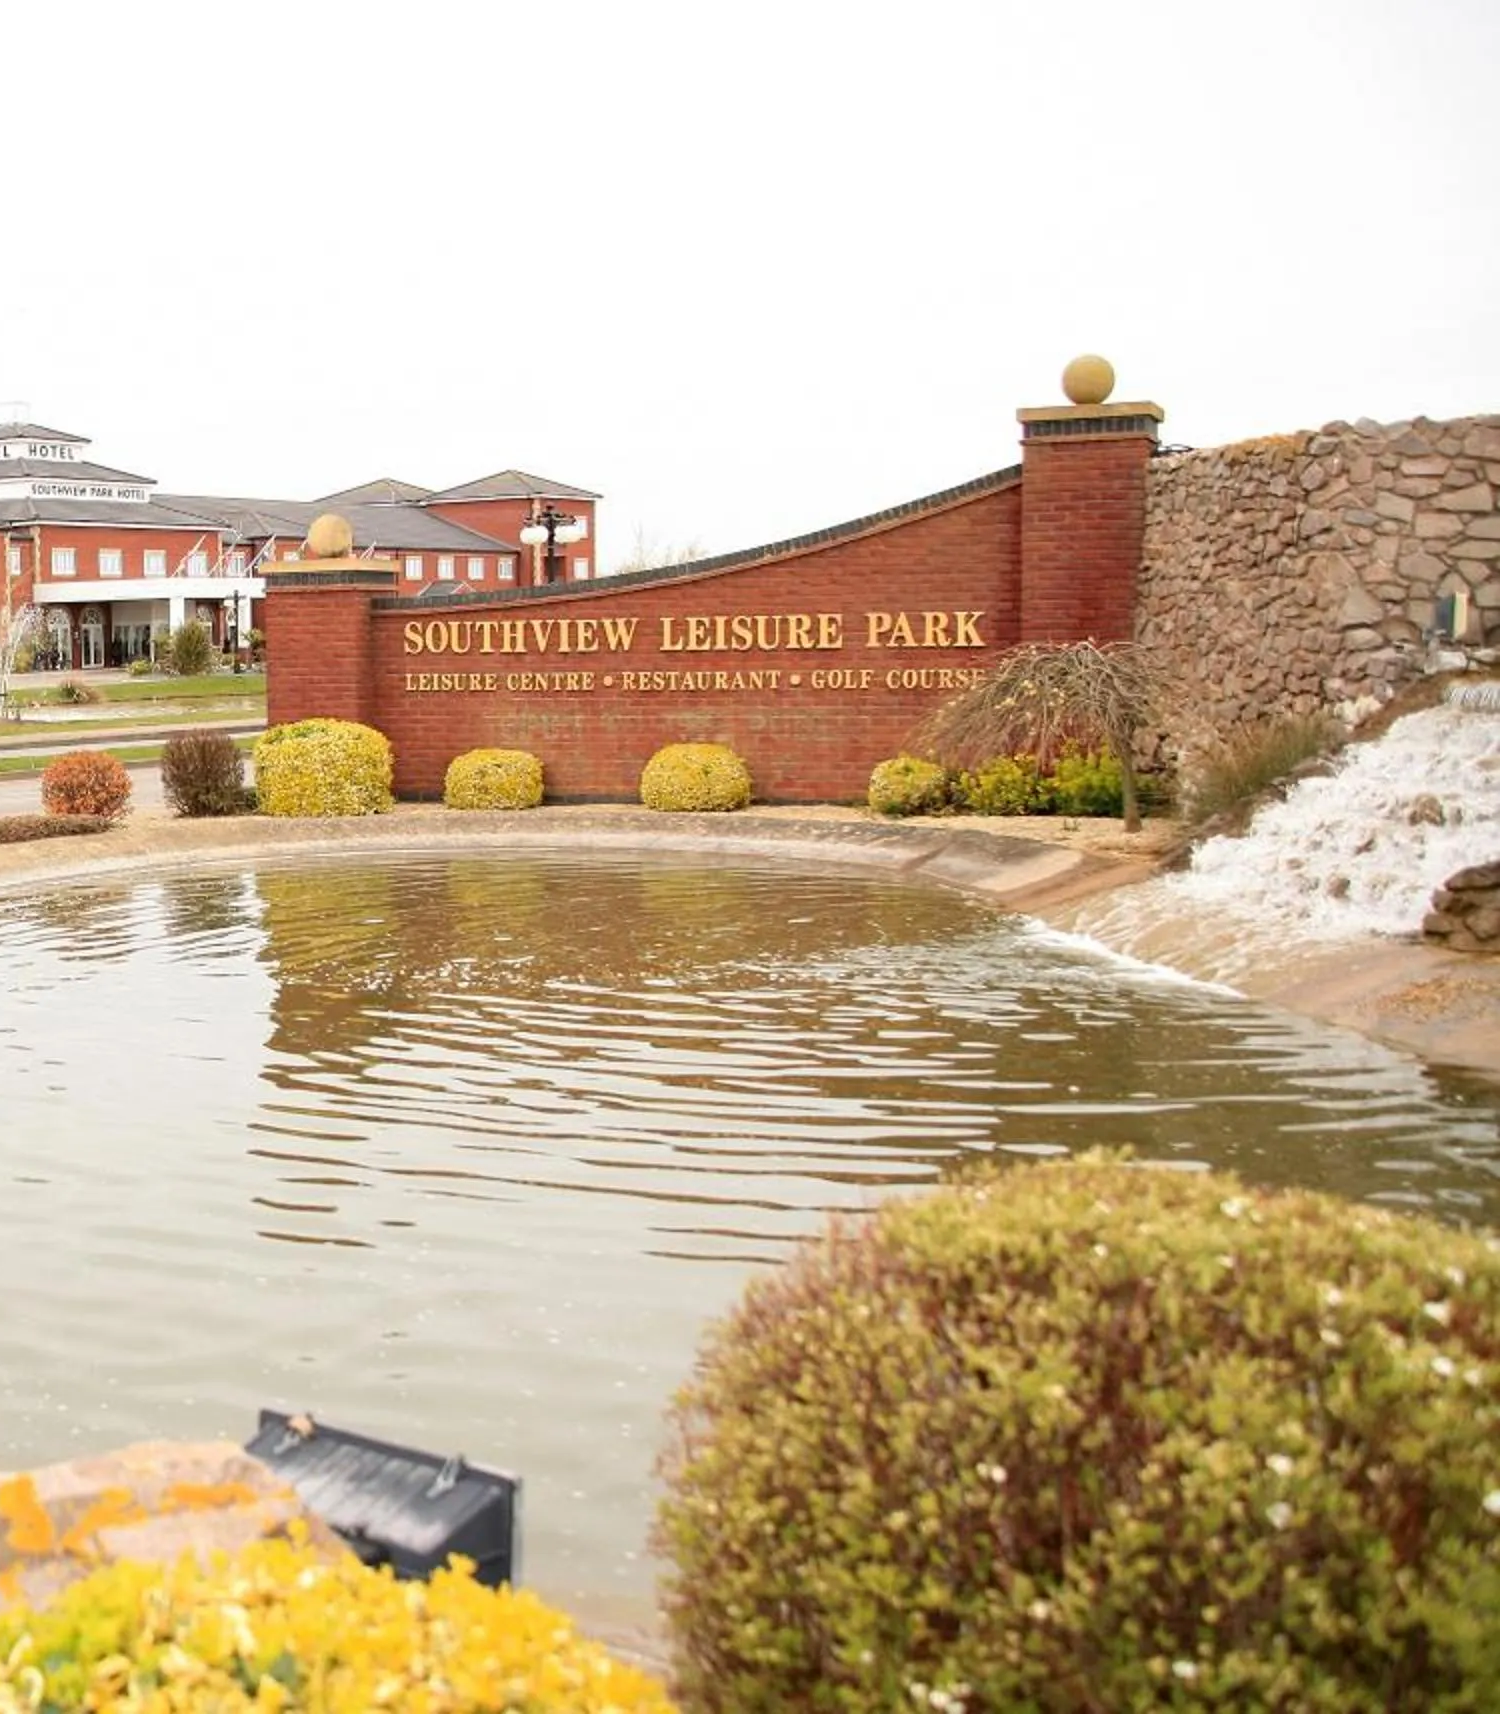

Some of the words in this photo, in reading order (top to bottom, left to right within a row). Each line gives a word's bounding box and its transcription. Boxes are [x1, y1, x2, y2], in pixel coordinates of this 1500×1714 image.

[28, 444, 75, 461] HOTEL
[32, 485, 87, 498] SOUTHVIEW
[90, 487, 114, 498] PARK
[117, 489, 146, 500] HOTEL
[404, 616, 640, 655] SOUTHVIEW
[660, 613, 844, 652] LEISURE
[866, 610, 988, 649] PARK
[405, 671, 498, 693] LEISURE
[506, 671, 596, 692] CENTRE
[621, 669, 782, 691] RESTAURANT
[811, 668, 875, 690] GOLF
